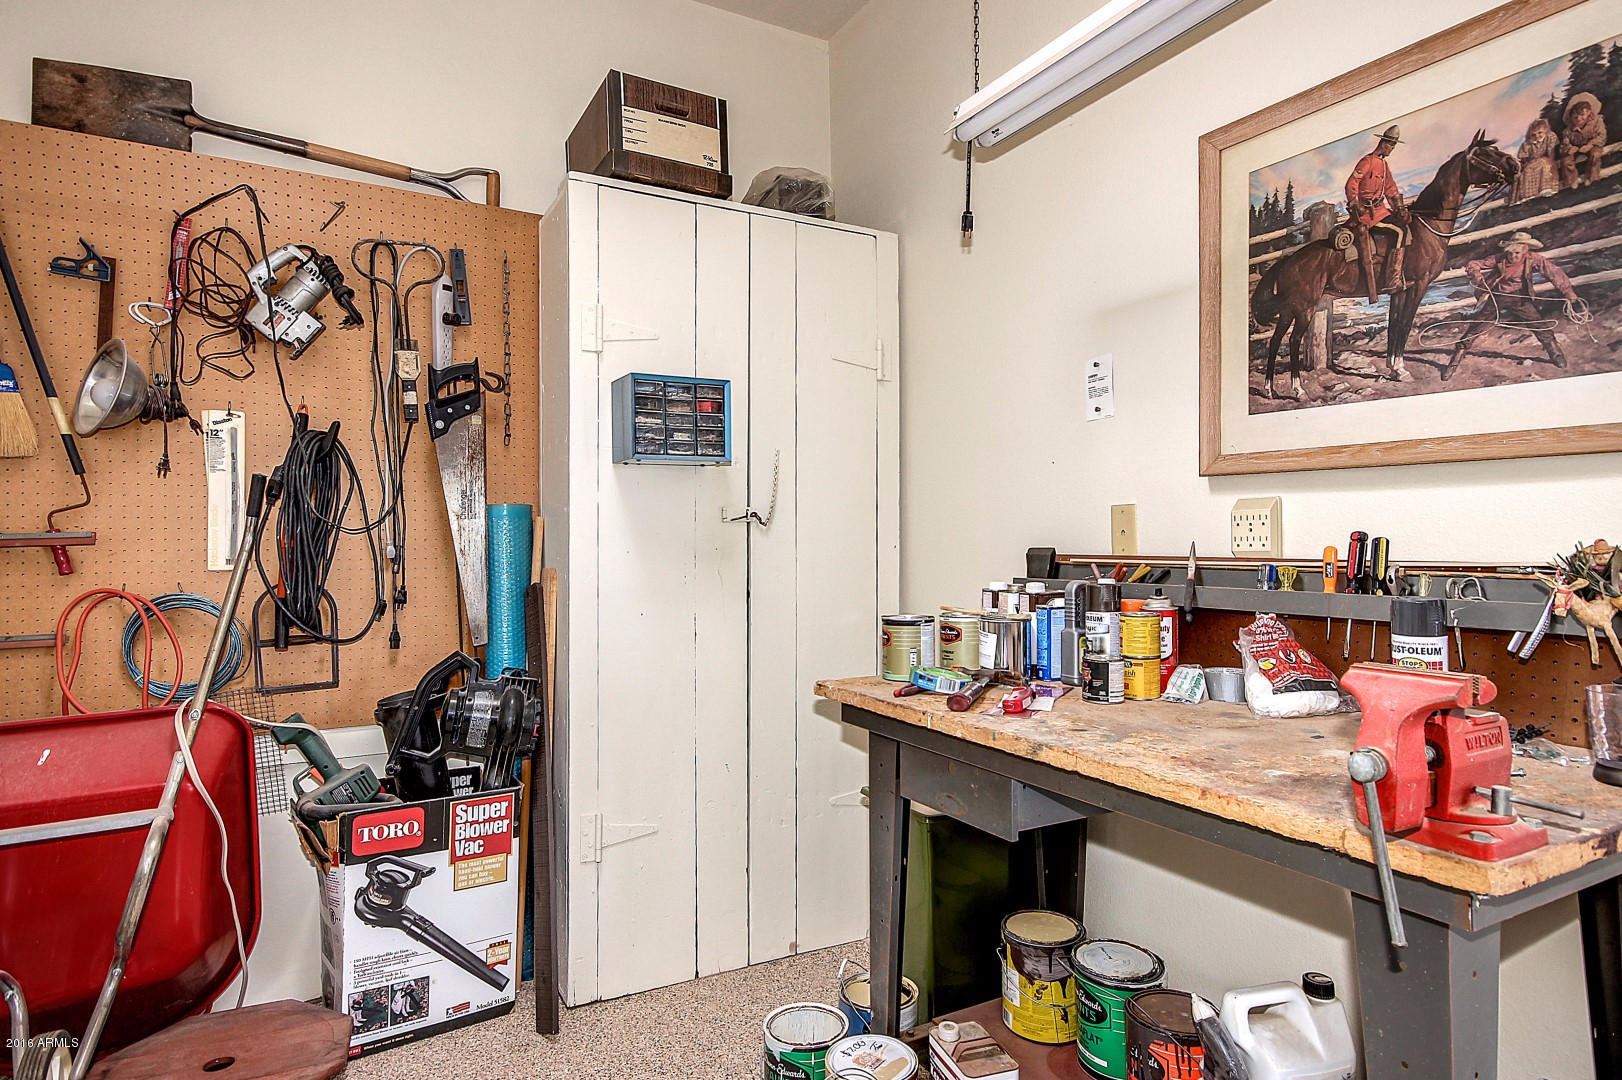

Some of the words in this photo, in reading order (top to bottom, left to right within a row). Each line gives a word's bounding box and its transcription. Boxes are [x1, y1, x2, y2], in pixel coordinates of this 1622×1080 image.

[1465, 731, 1501, 750] WILTON
[456, 801, 509, 824] Super
[358, 820, 419, 842] TORO
[455, 819, 510, 840] Blower
[455, 840, 484, 857] Vac
[476, 1001, 494, 1010] Model
